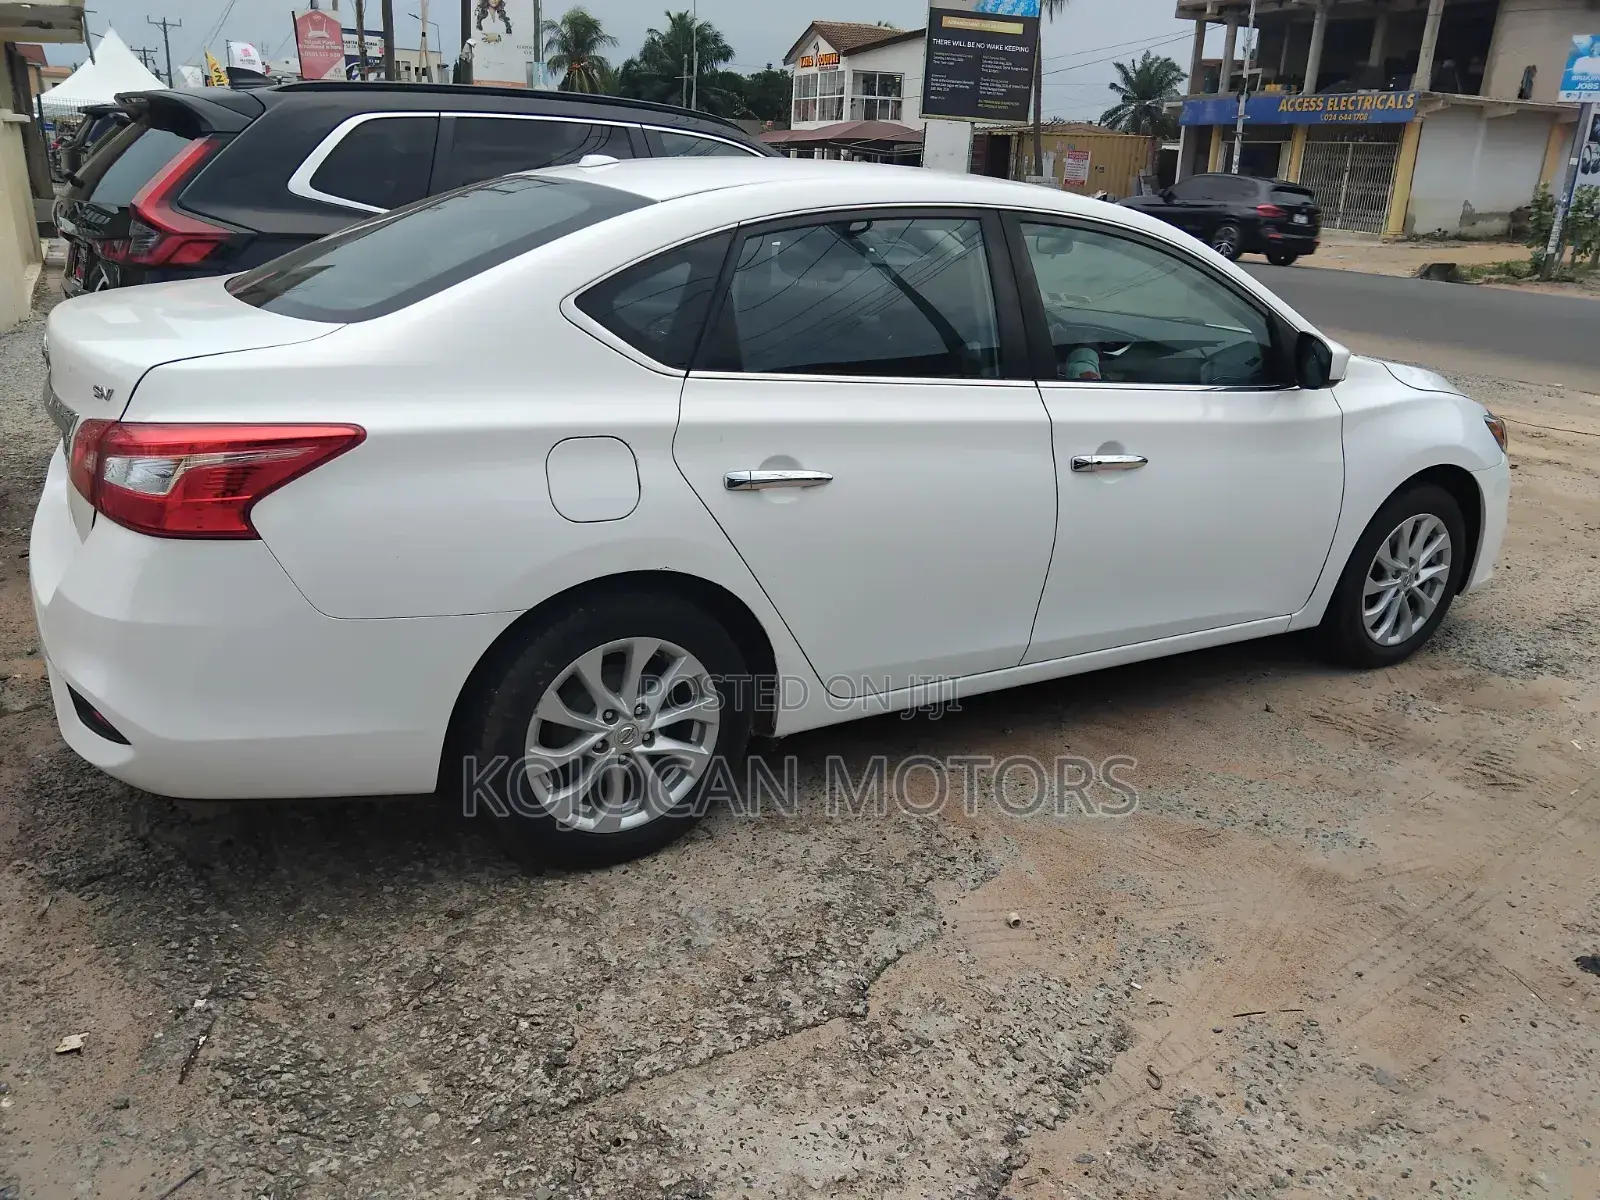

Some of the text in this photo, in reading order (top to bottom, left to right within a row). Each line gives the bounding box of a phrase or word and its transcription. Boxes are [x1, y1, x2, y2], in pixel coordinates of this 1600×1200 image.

[933, 38, 951, 46] THERE
[986, 43, 1003, 51] WAKE
[1004, 45, 1029, 53] KEEPING
[1575, 82, 1600, 90] JOBS
[1278, 93, 1416, 112] ACCESS ELECTRICALS
[93, 385, 114, 402] SV
